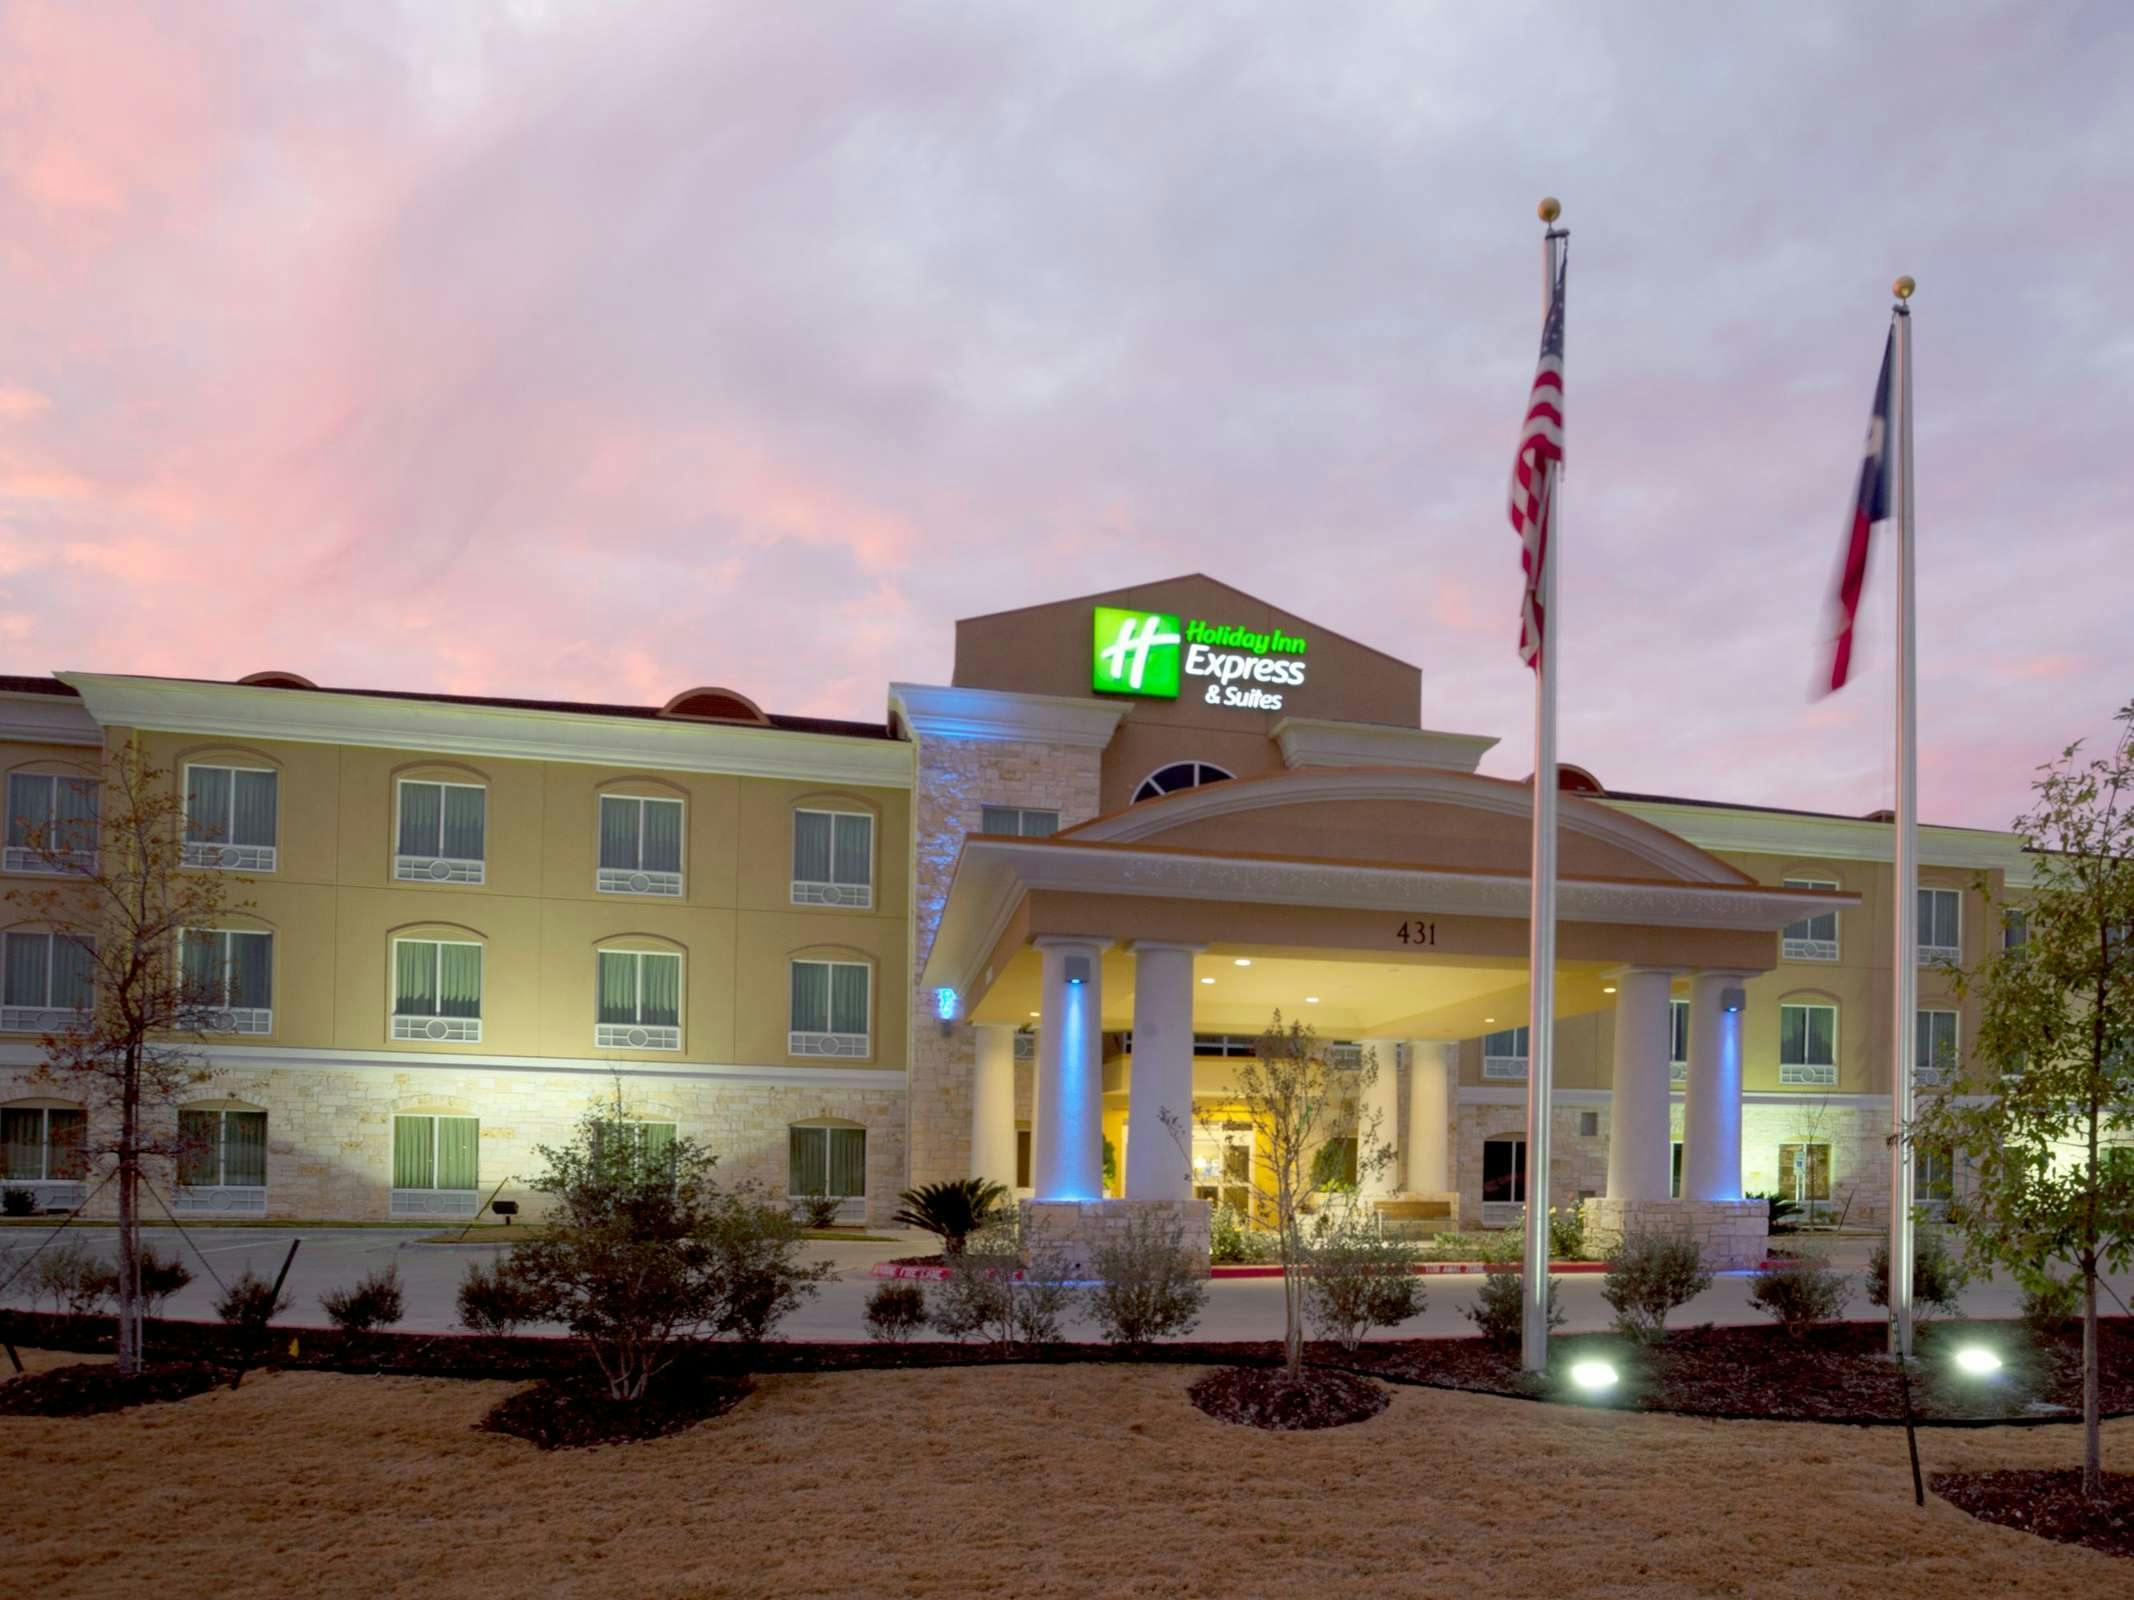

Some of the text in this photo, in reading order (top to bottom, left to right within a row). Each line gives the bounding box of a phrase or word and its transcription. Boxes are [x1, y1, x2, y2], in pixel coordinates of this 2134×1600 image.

[1186, 620, 1306, 654] Holiday Inn
[1185, 643, 1306, 686] Express
[1205, 684, 1283, 710] & Suites
[1396, 919, 1435, 945] 431
